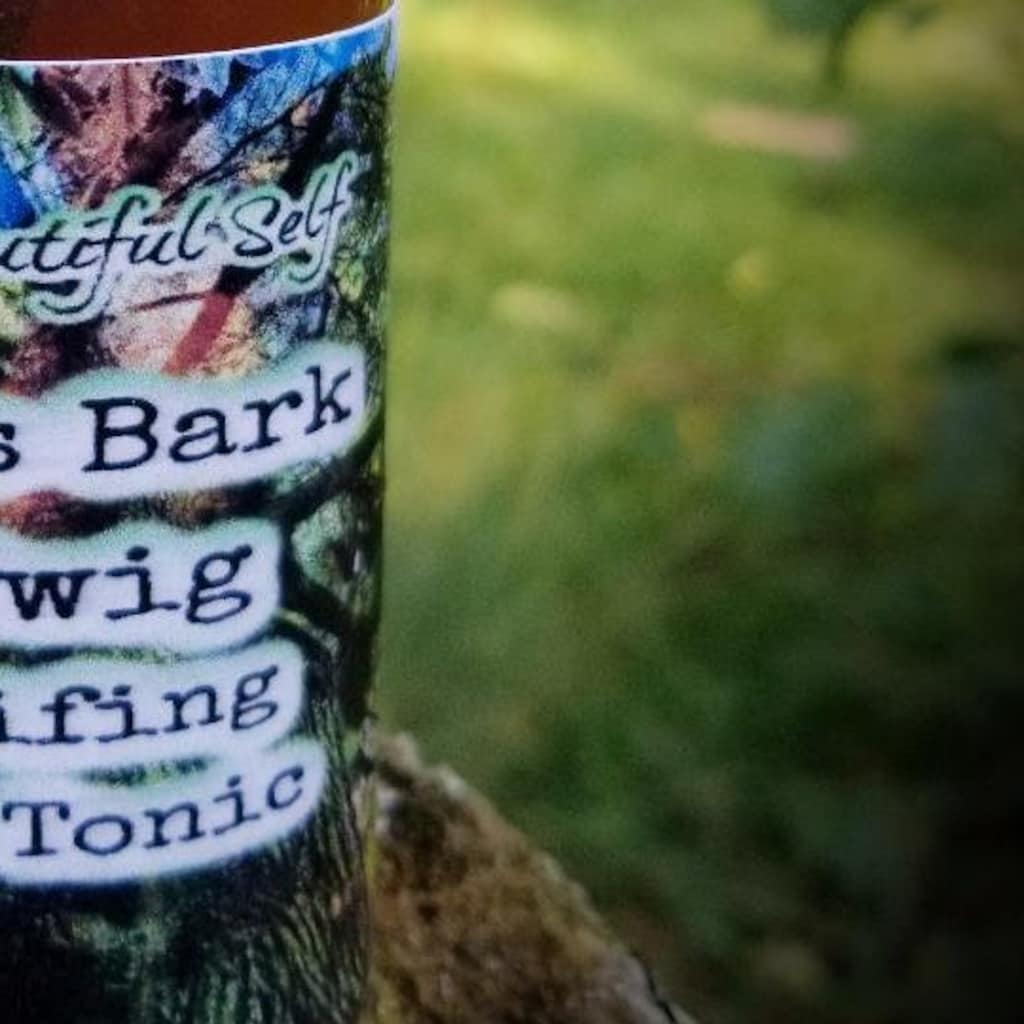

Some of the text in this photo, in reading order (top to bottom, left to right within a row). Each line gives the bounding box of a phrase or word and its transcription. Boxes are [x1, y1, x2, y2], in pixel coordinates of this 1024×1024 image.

[233, 162, 356, 292] Self
[81, 365, 355, 474] Bark
[2, 766, 306, 858] Tonic
